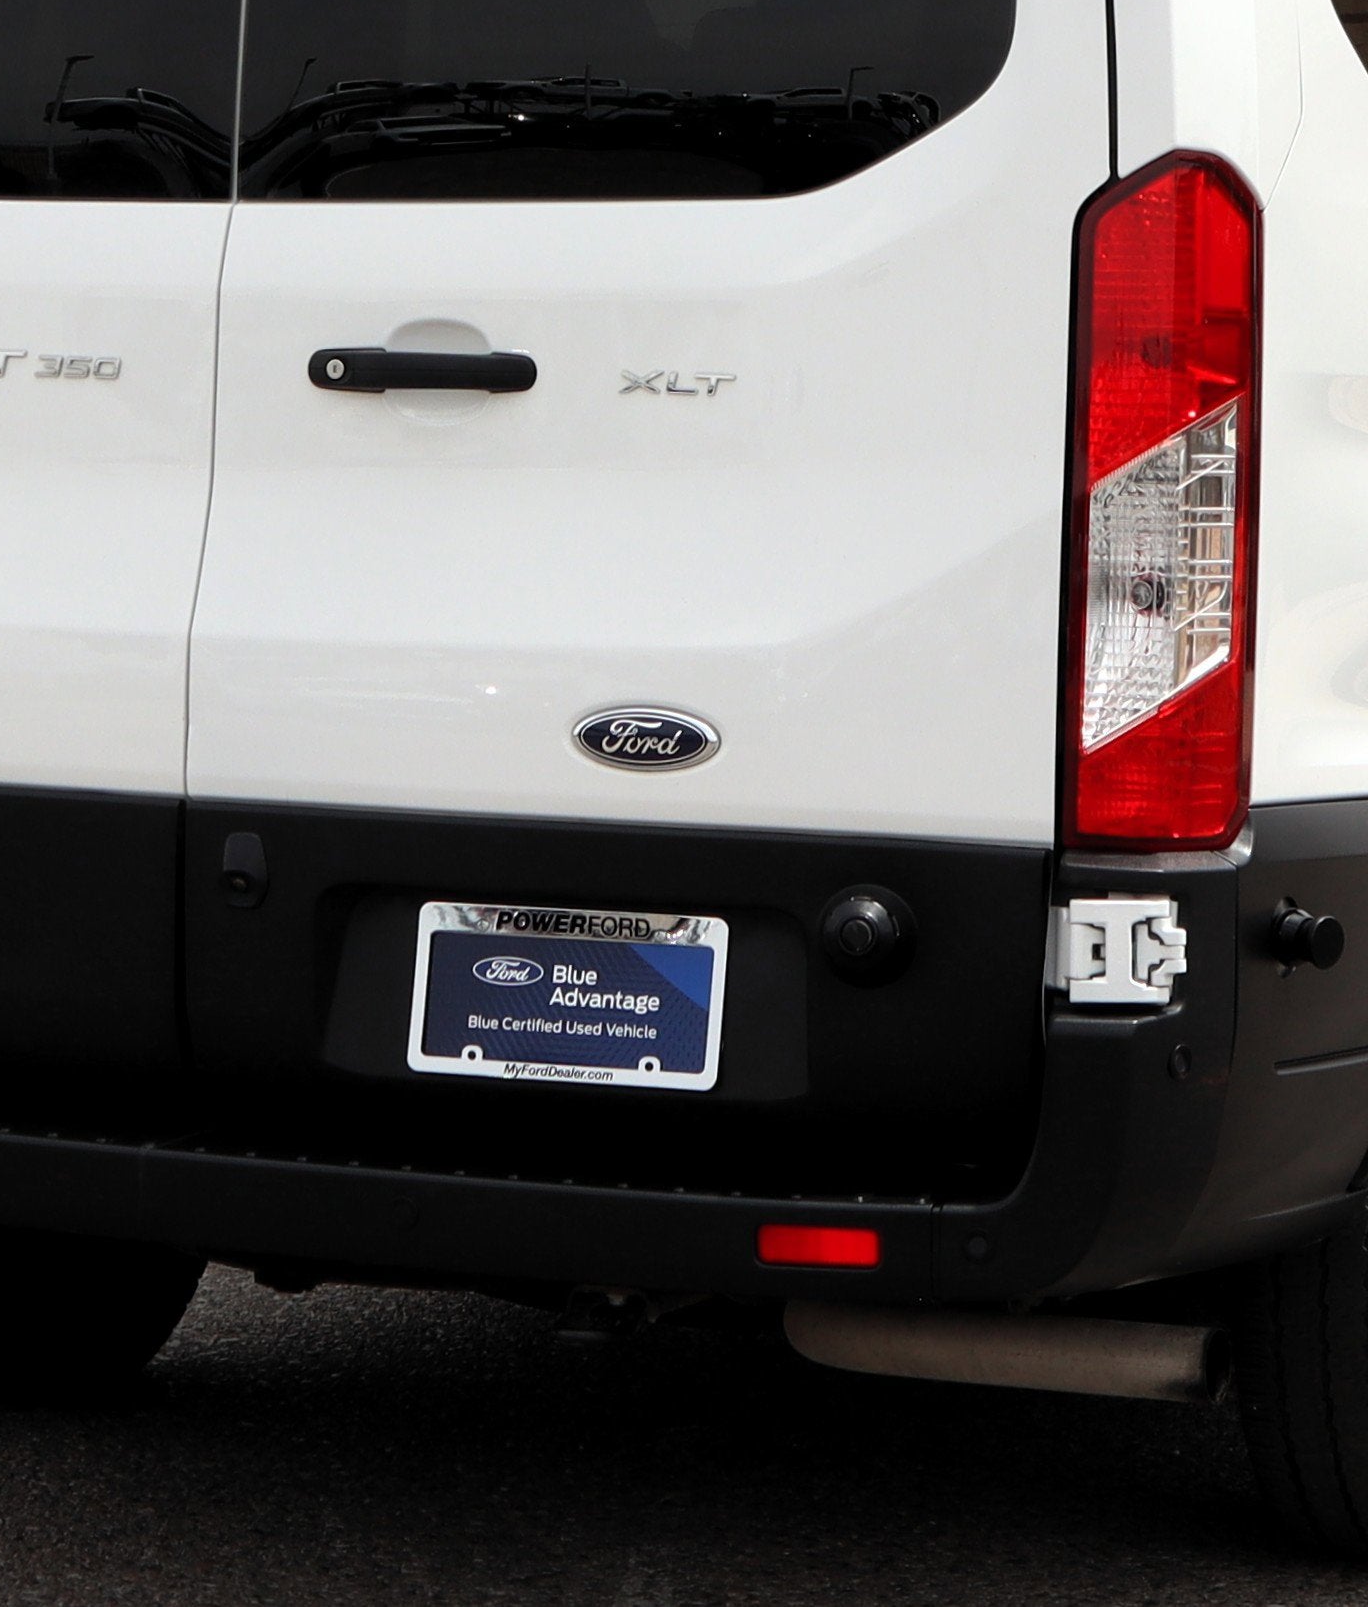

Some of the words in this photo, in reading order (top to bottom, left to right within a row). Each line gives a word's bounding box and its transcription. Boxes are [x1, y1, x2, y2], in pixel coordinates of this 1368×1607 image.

[34, 353, 123, 380] 350
[617, 368, 738, 396] XLT
[601, 719, 683, 755] Ford
[485, 957, 531, 983] Ford
[552, 964, 597, 986] Blue
[549, 987, 660, 1014] Advantage
[467, 1015, 499, 1031] Blue
[501, 1016, 562, 1034] Certified
[566, 1020, 602, 1036] Used
[605, 1022, 658, 1040] Vehicle
[503, 1063, 614, 1082] MyFordDealer.com
